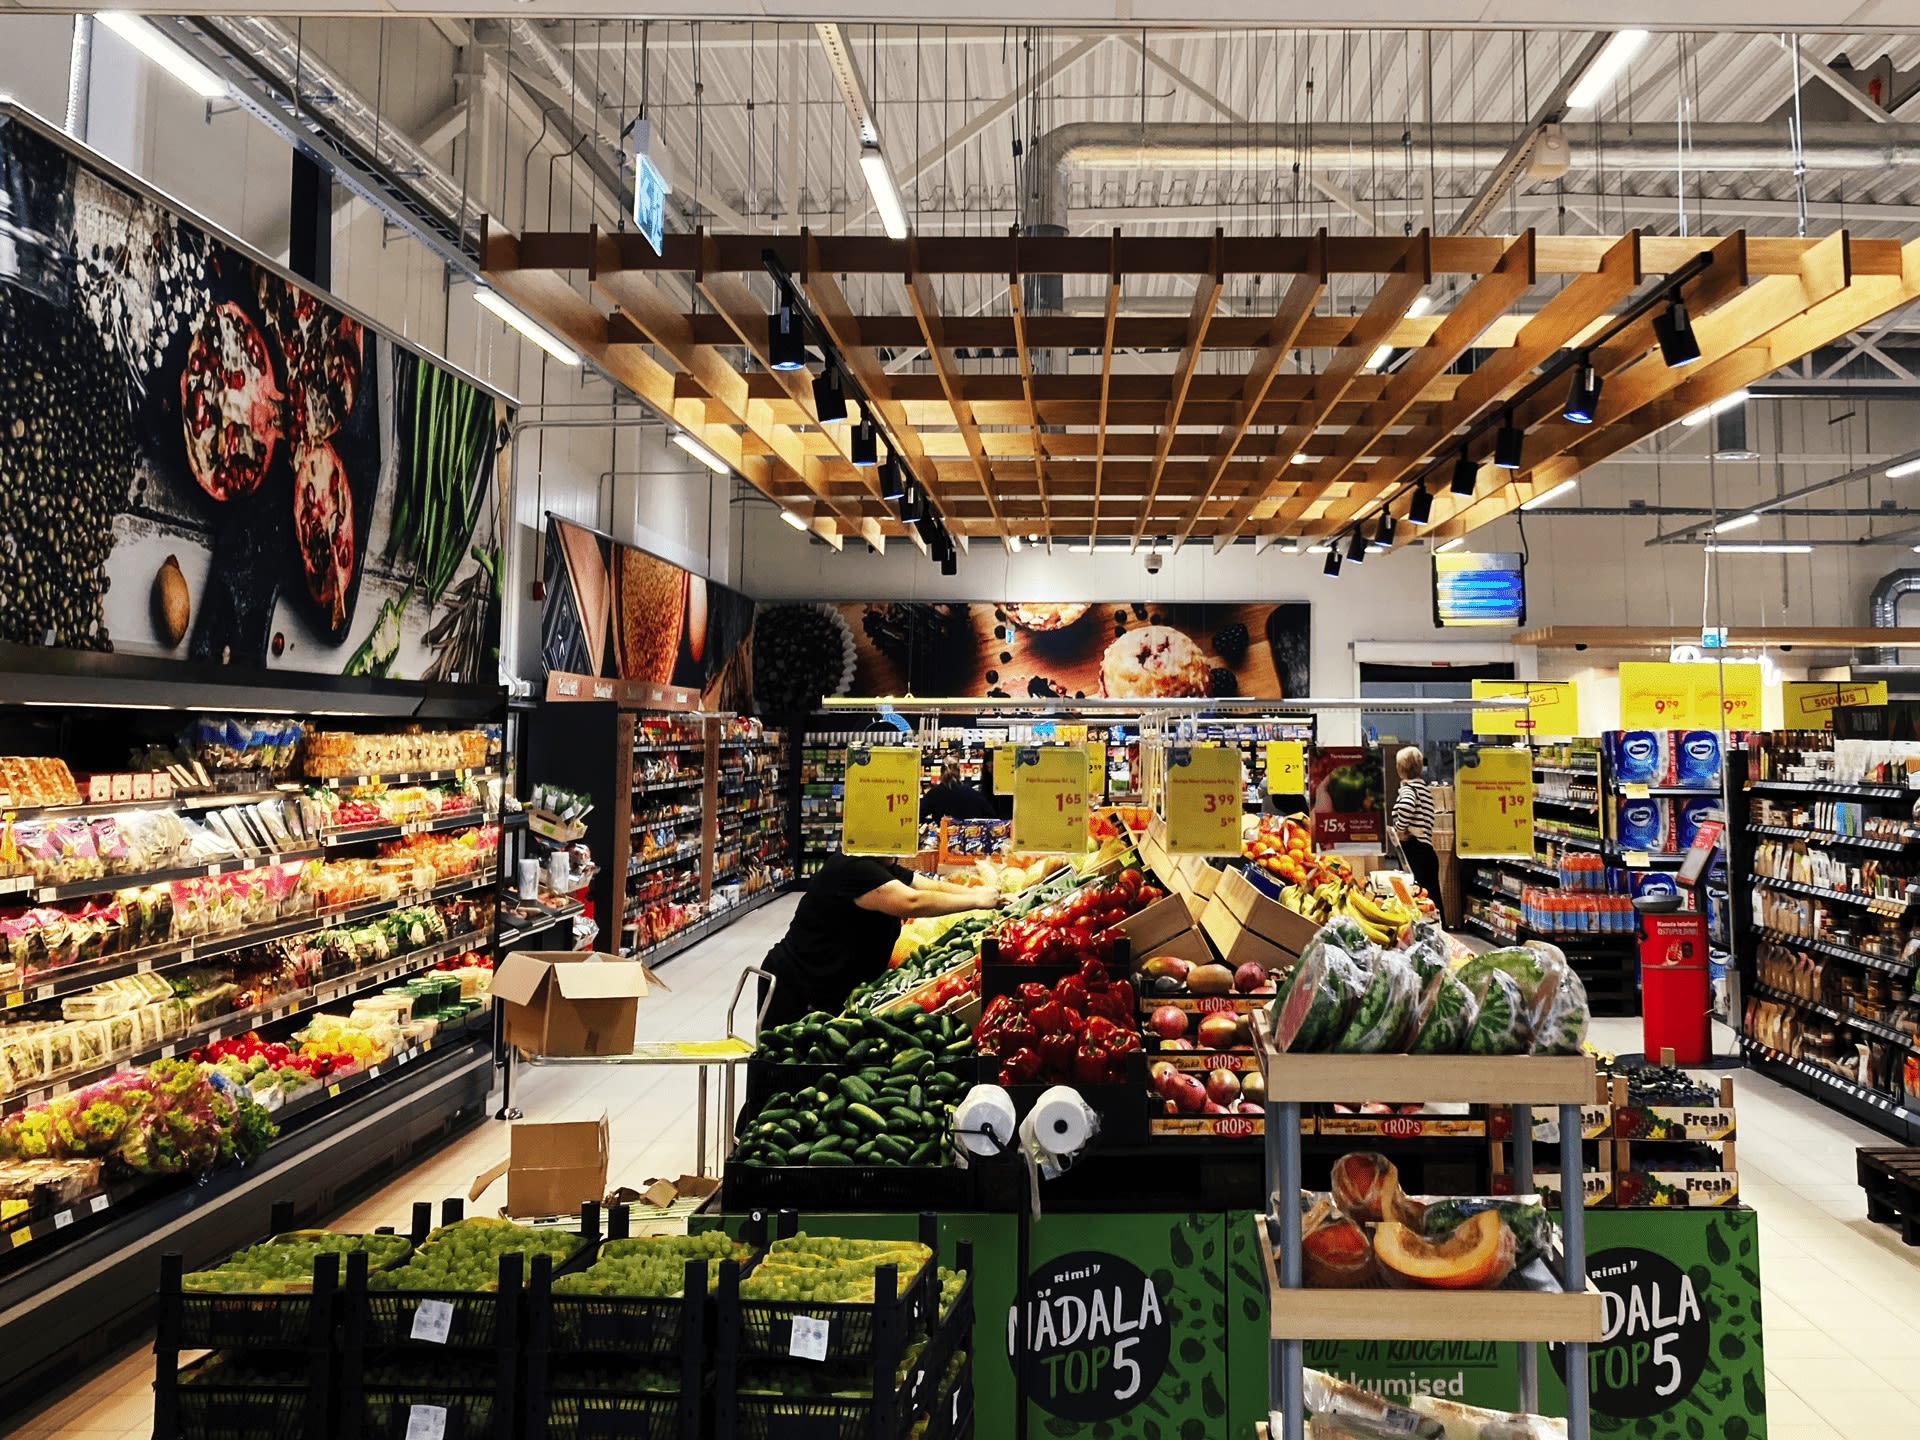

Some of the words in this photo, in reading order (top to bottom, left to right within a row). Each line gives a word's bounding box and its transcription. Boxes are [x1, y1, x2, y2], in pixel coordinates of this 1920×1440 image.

[1199, 996, 1232, 1010] TROPS
[1206, 1053, 1241, 1069] TROPS
[1215, 1116, 1252, 1134] TROPS
[1383, 1117, 1421, 1135] TROPS
[1683, 1112, 1729, 1126] Fresh
[1685, 1177, 1732, 1191] Fresh
[1054, 1266, 1090, 1283] Rimi
[1591, 1263, 1627, 1279] Rimi
[1600, 1274, 1701, 1342] DALA
[1040, 1346, 1111, 1398] TOP
[1113, 1336, 1141, 1400] 5
[1587, 1341, 1649, 1394] TOP
[1653, 1332, 1681, 1396] 5
